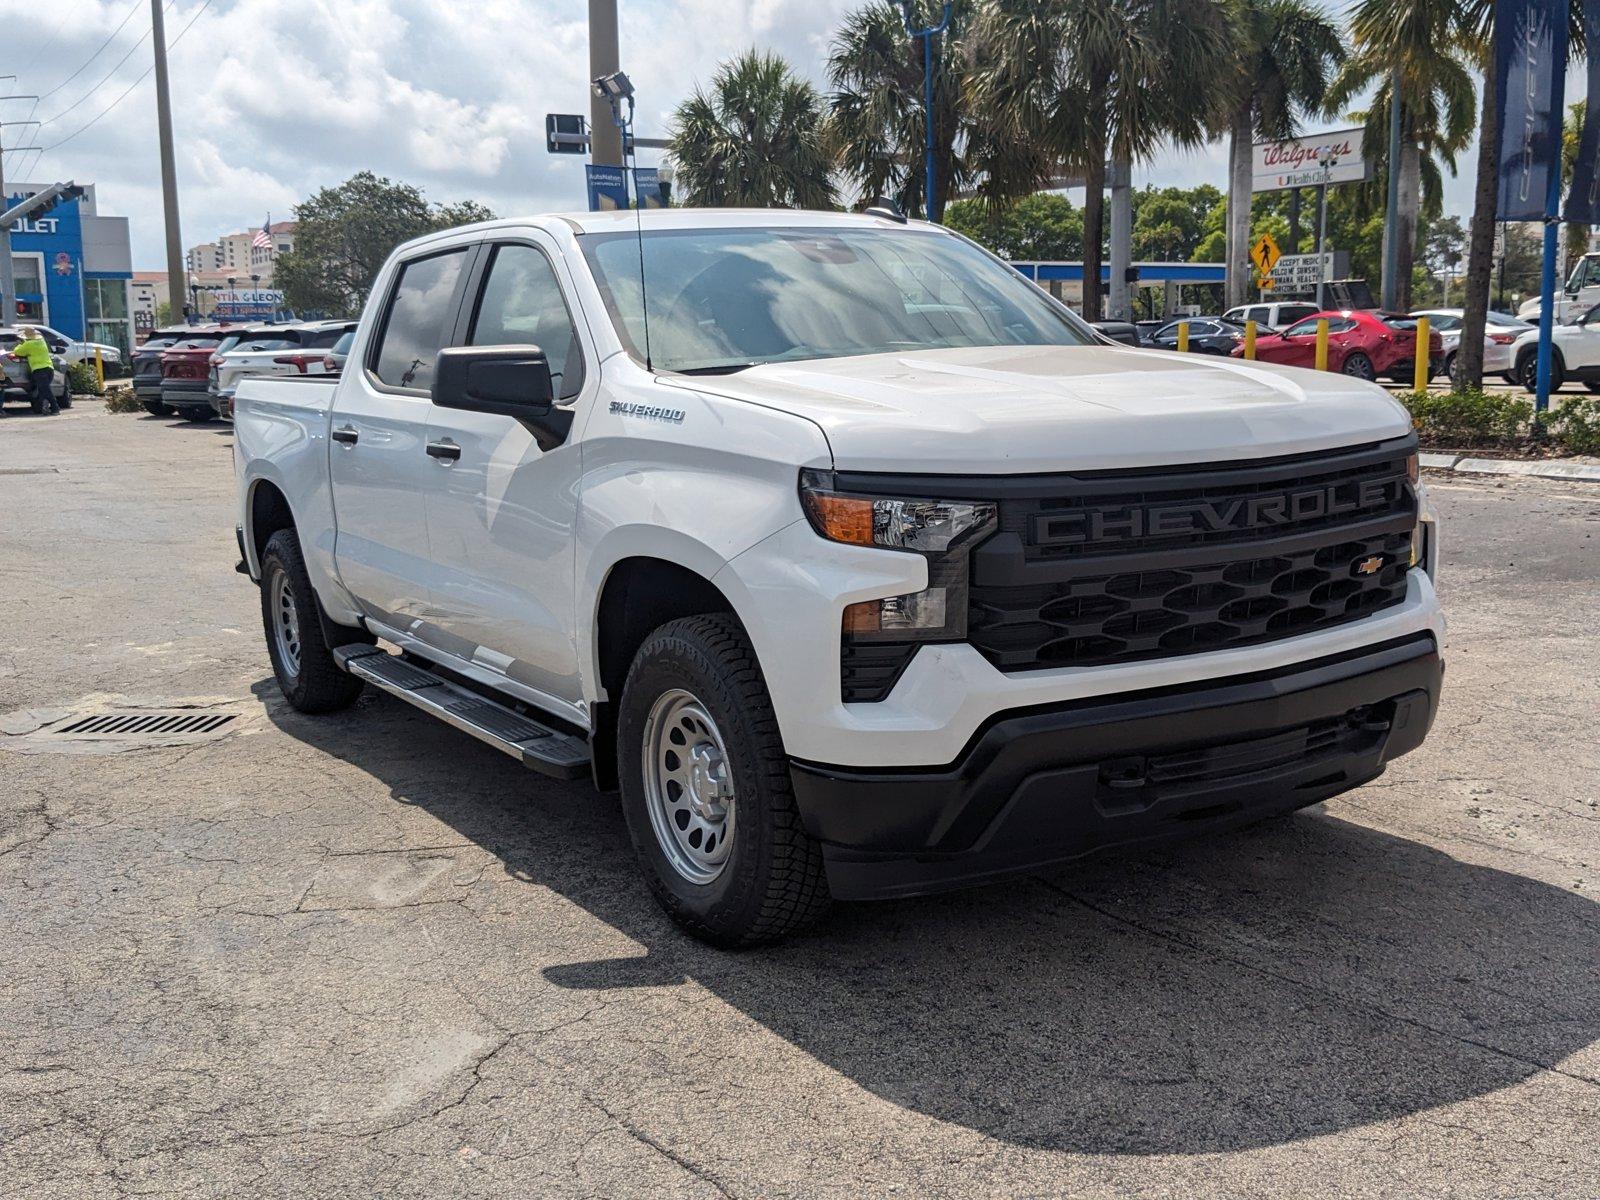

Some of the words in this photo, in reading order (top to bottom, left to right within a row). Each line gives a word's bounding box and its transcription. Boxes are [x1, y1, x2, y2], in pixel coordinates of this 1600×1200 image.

[1263, 140, 1352, 169] Walgrens
[608, 401, 686, 422] SILVERADO
[1036, 476, 1403, 544] CHEVROLET
